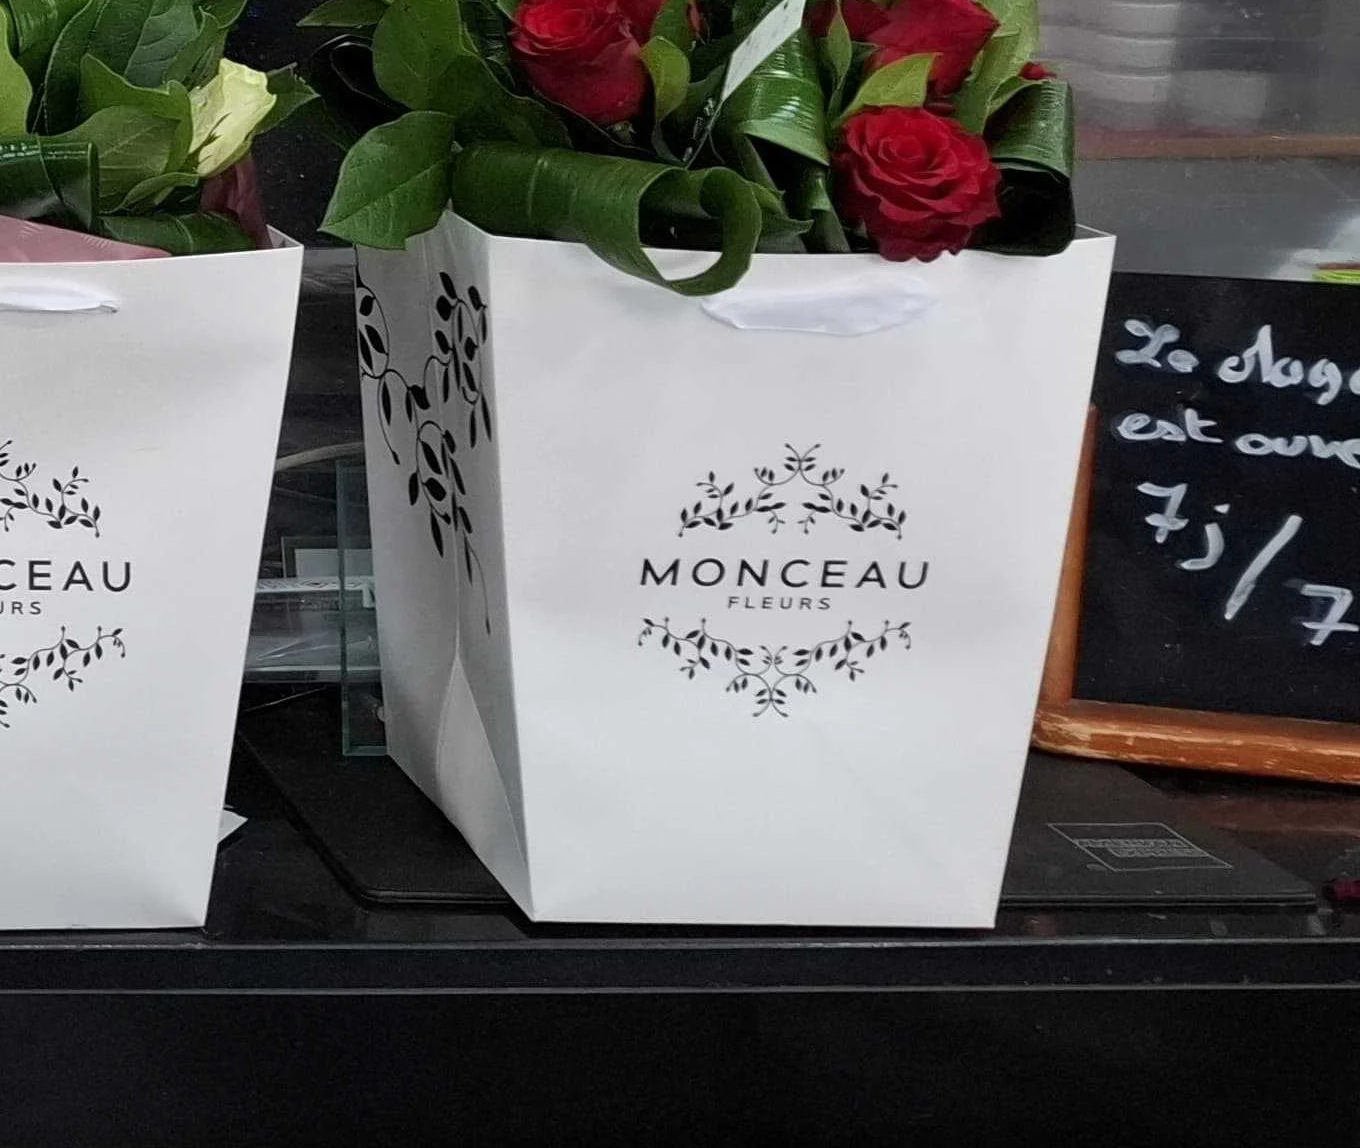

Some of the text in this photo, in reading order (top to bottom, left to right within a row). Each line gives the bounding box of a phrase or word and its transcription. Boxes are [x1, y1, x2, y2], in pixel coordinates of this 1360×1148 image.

[1117, 408, 1224, 444] est
[640, 558, 929, 589] MONCEAU
[727, 596, 832, 610] FLEURS
